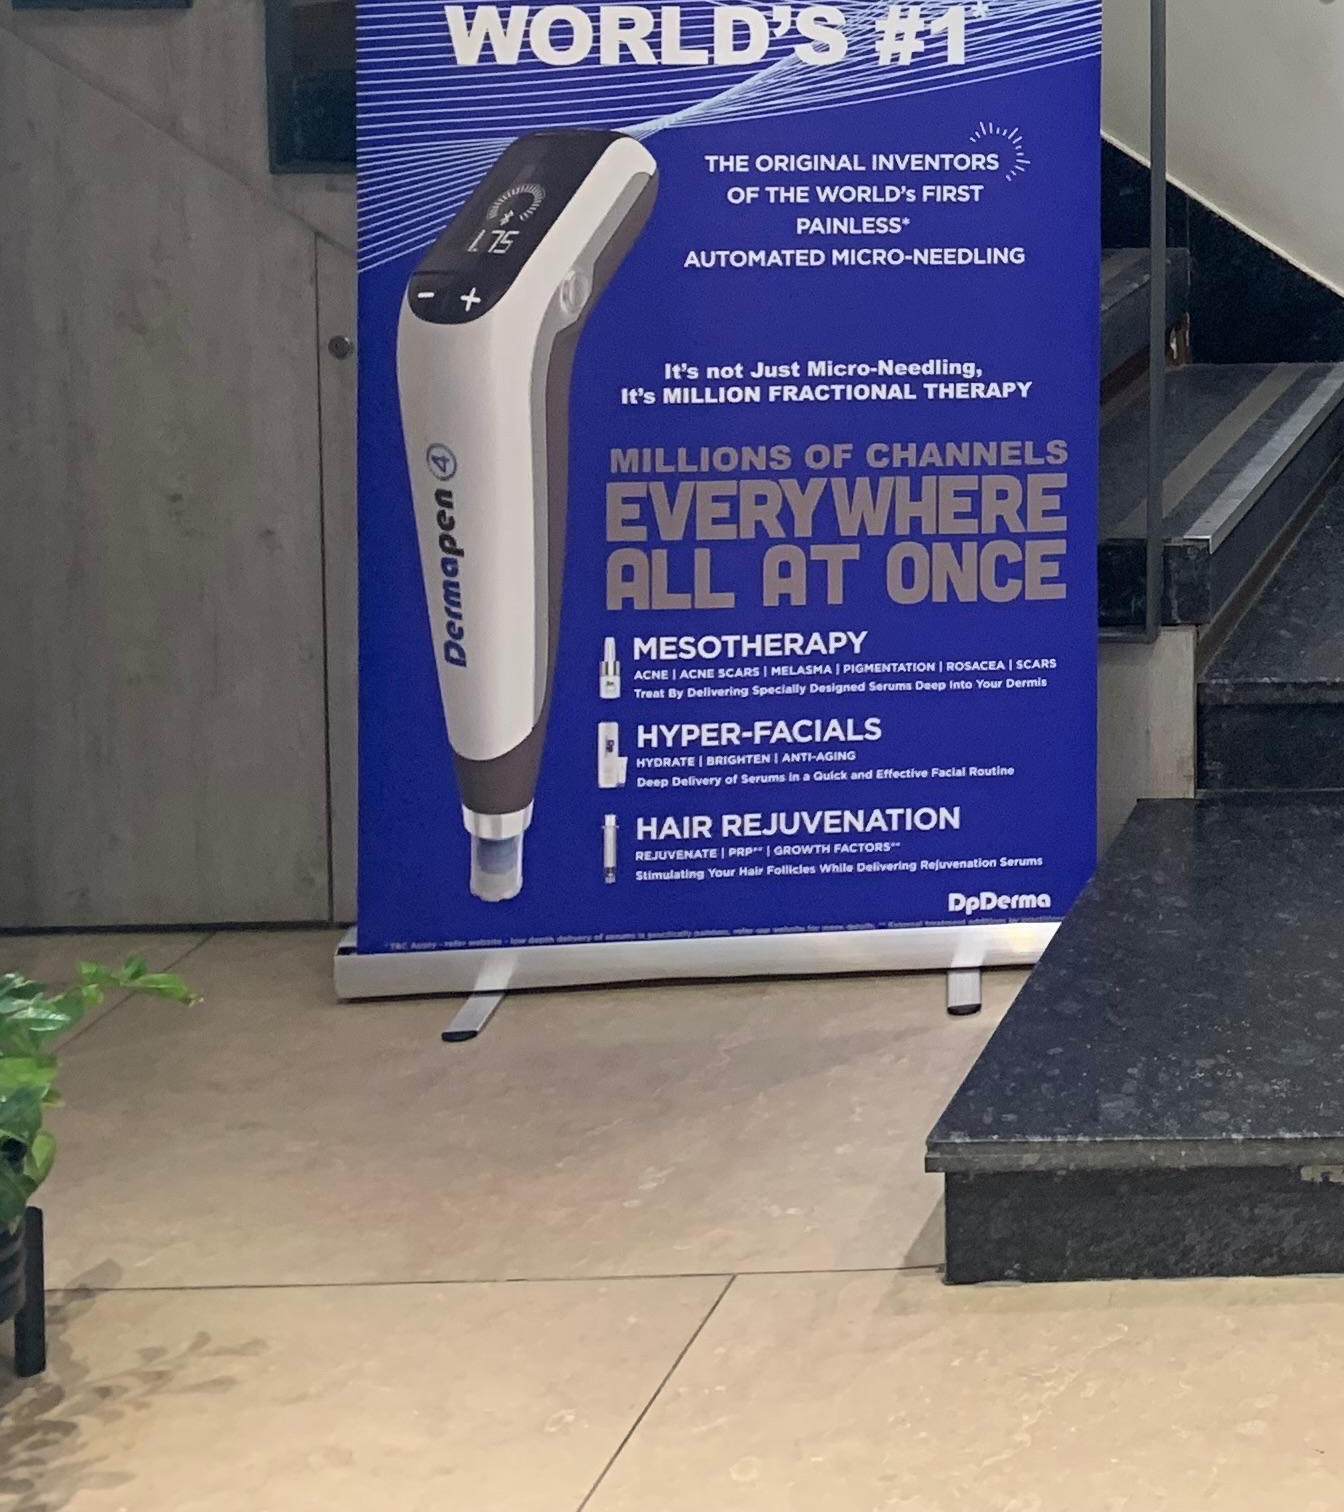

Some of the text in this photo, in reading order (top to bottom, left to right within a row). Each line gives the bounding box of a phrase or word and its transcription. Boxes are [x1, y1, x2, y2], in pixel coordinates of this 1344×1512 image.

[444, 3, 848, 66] WORLD'S
[704, 153, 1000, 173] THE ORIGINAL INVENTORS
[727, 184, 984, 204] OF THE WORLD's FIRST
[684, 247, 1026, 268] AUTOMATED MICRO-NEEDLING
[664, 359, 983, 380] It's not Just Micro-Needling,
[621, 381, 1033, 405] It's MILLION FRACTIONAL THERAPY
[610, 440, 1069, 473] MILLIONS OF CHANNELS
[605, 473, 1068, 542] EVERYWHERE
[433, 488, 468, 668] Dermapen
[606, 539, 1067, 611] ALL AT ONCE
[633, 631, 868, 661] MESOTHERAPY
[634, 658, 1057, 681] ACNE ACNE SCARS MELASMA PIGMENTATION ROSACEA SCARS
[634, 676, 1047, 700] Treat By Delivering Specially Designed Serums Deep Your Dermis
[637, 717, 882, 748] HYPER-FACIALS
[636, 750, 856, 768] HYDRATE BRIGHTEN ANTI-AGING
[637, 765, 1015, 788] Deep Delivery of Serums Quick and Effective Facial Routine
[636, 806, 960, 841] HAIR REJUVENATION
[635, 848, 718, 861] REJUVENATE
[774, 844, 831, 856] GROWTH
[635, 856, 1043, 881] Stimulating Your Hair Follicles While Delivering Rejuvenation Serums
[948, 892, 1051, 915] DpDerma
